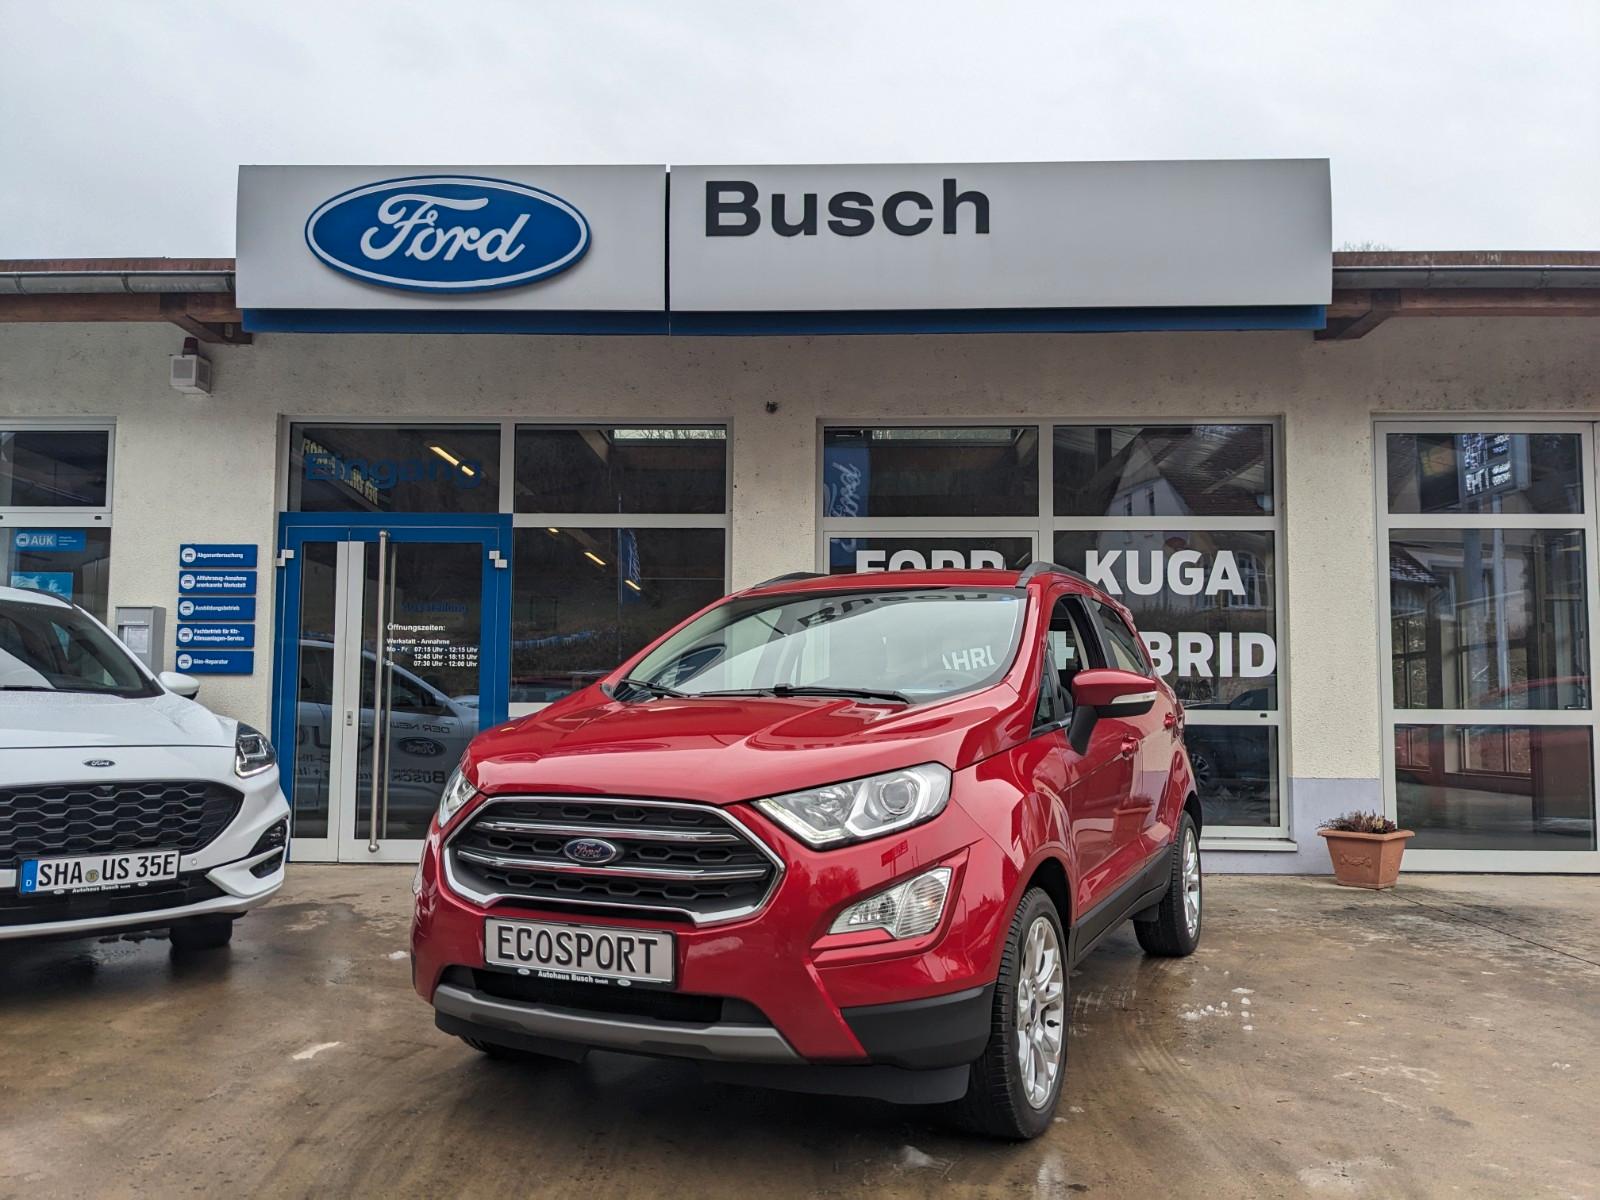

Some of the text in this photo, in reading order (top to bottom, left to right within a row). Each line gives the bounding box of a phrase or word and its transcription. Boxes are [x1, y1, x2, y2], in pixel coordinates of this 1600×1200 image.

[706, 179, 990, 237] Busch
[361, 193, 532, 262] Ford
[31, 536, 53, 545] AUK
[1086, 550, 1246, 596] KUGA
[387, 622, 446, 632] Öffnungszeiten:
[38, 853, 176, 887] SHA US 35E
[25, 879, 32, 887] D
[72, 885, 100, 893] Autohaus
[101, 884, 119, 892] Busch
[497, 924, 659, 974] ECOSPORT
[537, 970, 570, 981] Autohaus
[571, 973, 594, 984] Busch
